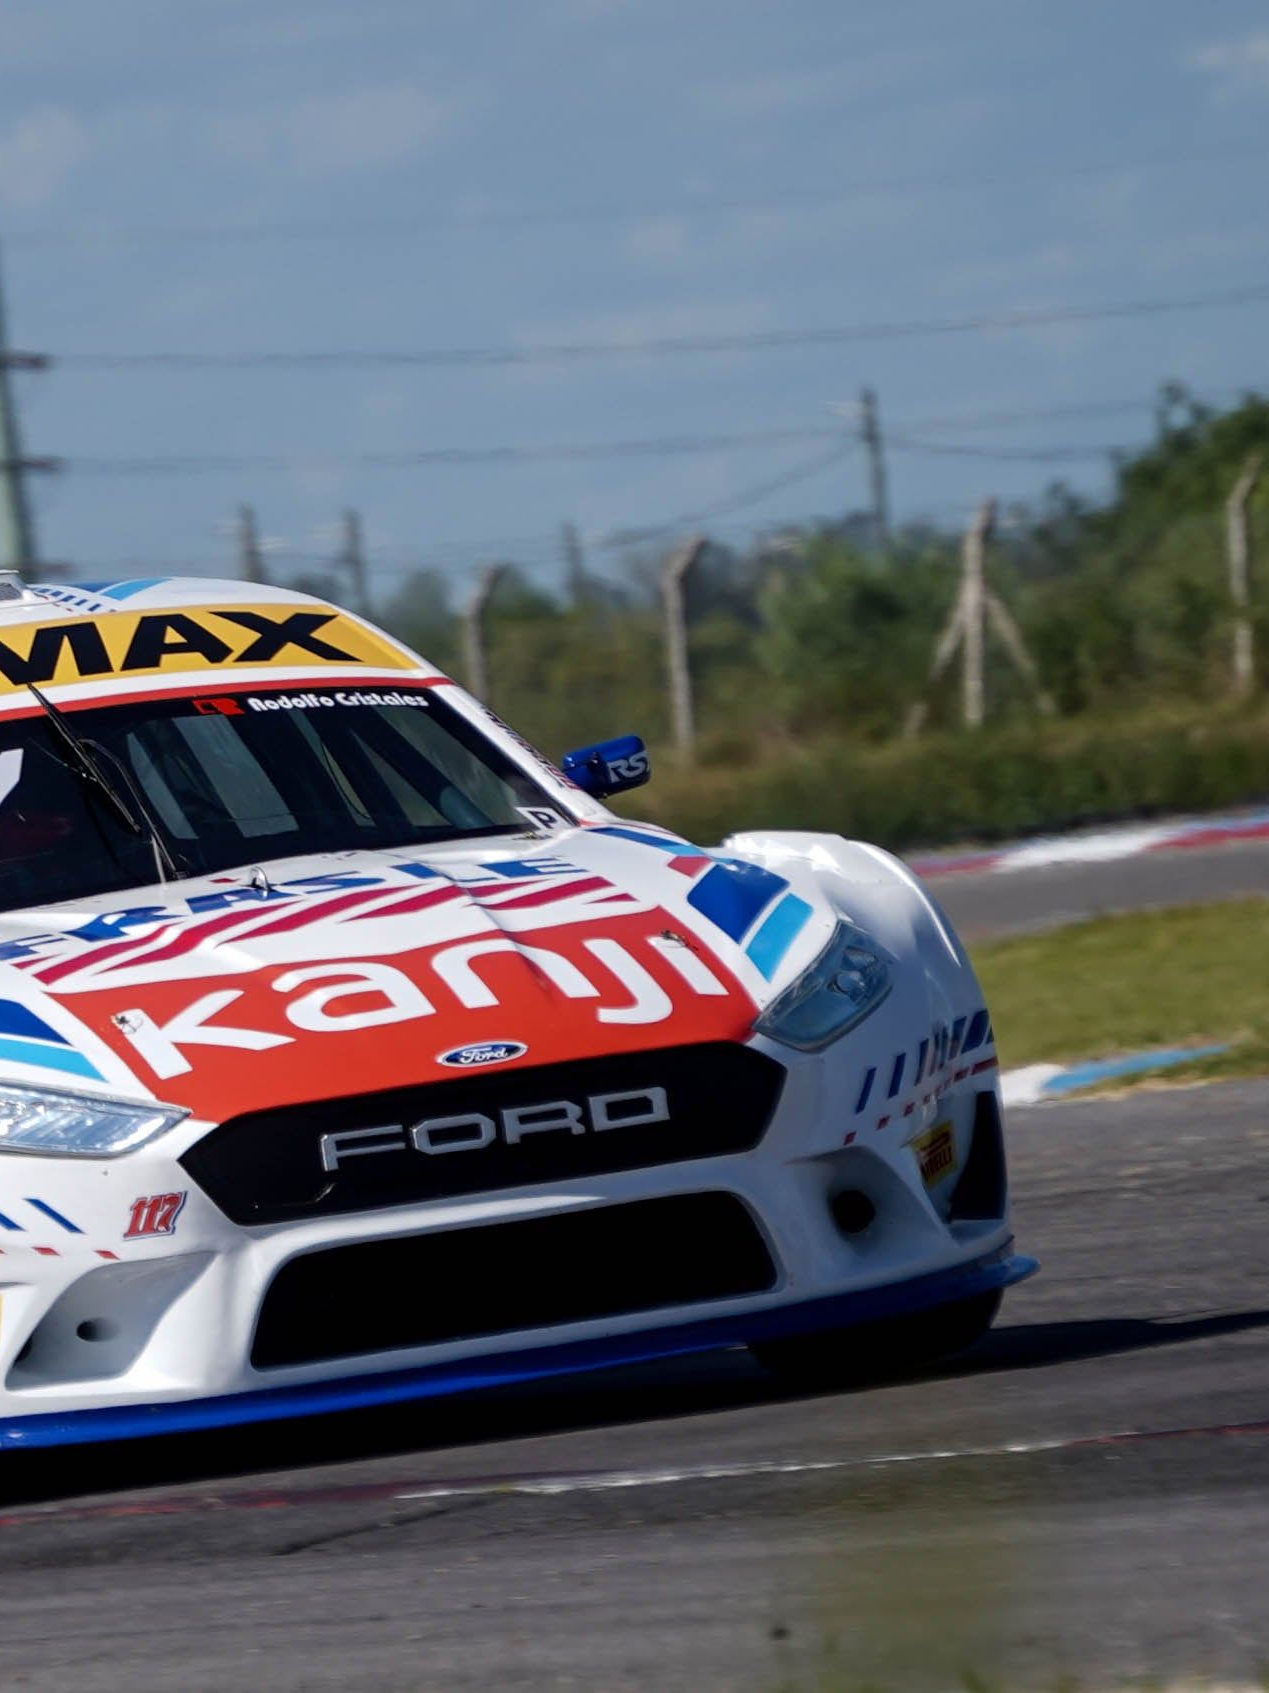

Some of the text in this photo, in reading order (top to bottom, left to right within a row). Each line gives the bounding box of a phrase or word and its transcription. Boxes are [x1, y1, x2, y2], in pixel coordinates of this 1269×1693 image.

[248, 693, 335, 712] Rodolfo
[335, 692, 429, 708] Cristales
[607, 752, 651, 784] RS
[119, 937, 729, 1080] kanji
[459, 1046, 509, 1064] Ford
[320, 1085, 670, 1173] FORD
[122, 1191, 186, 1241] 117
